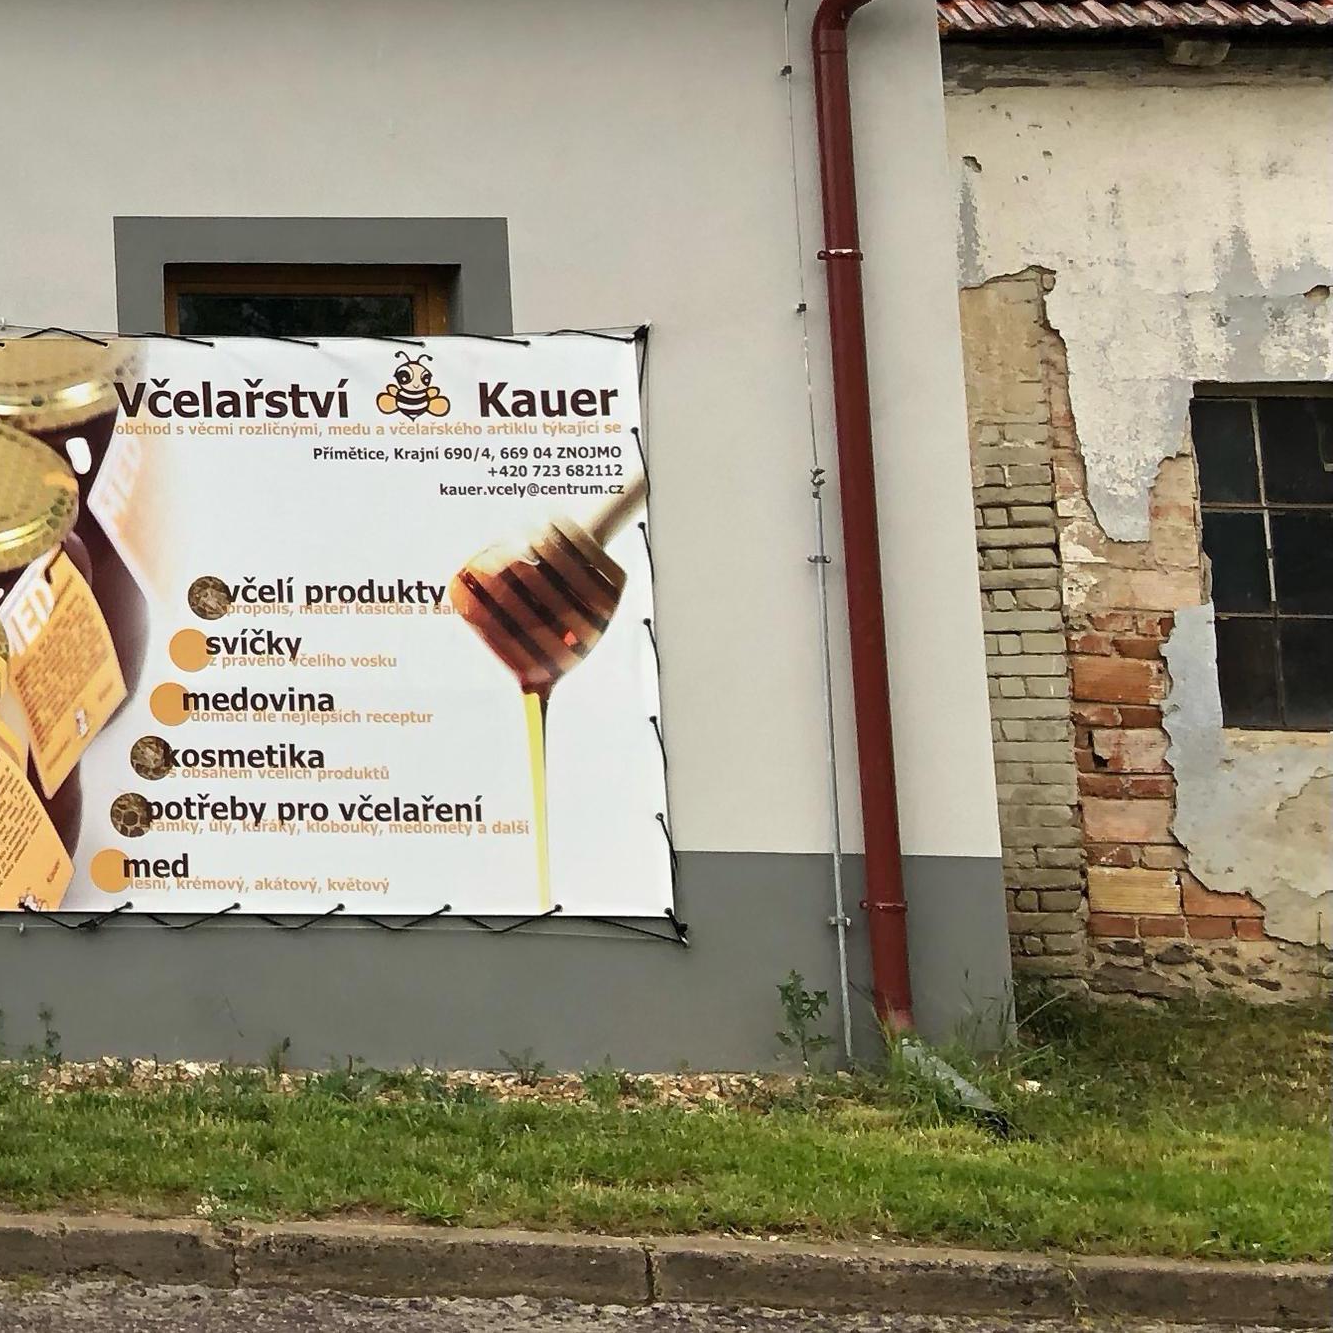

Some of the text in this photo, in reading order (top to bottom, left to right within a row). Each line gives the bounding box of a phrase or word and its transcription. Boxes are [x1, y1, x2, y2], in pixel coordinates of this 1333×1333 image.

[113, 378, 618, 419] Včelařství Kauer
[115, 422, 622, 438] obchod s věcmi rozličnými, medu a včelařského artiklu týkající se
[313, 446, 622, 463] Přímětice, Krajní 690/4, 669 04 ZNOJMO
[487, 464, 623, 478] +420 723 682112
[439, 483, 624, 498] kauer.vcely@centrum.cz
[225, 577, 446, 609] včelí produkty
[205, 629, 302, 661] svíčky
[351, 654, 398, 668] vosku
[182, 687, 334, 711] medovina
[367, 710, 434, 726] receptur
[164, 744, 325, 769] kosmetika
[317, 766, 390, 782] produktů
[147, 793, 483, 827] potřeby pro včelaření
[477, 824, 487, 834] a
[491, 820, 530, 834] další
[123, 853, 189, 878] med
[176, 876, 250, 894] krémový,
[254, 877, 322, 894] akátový,
[327, 876, 390, 894] květový
